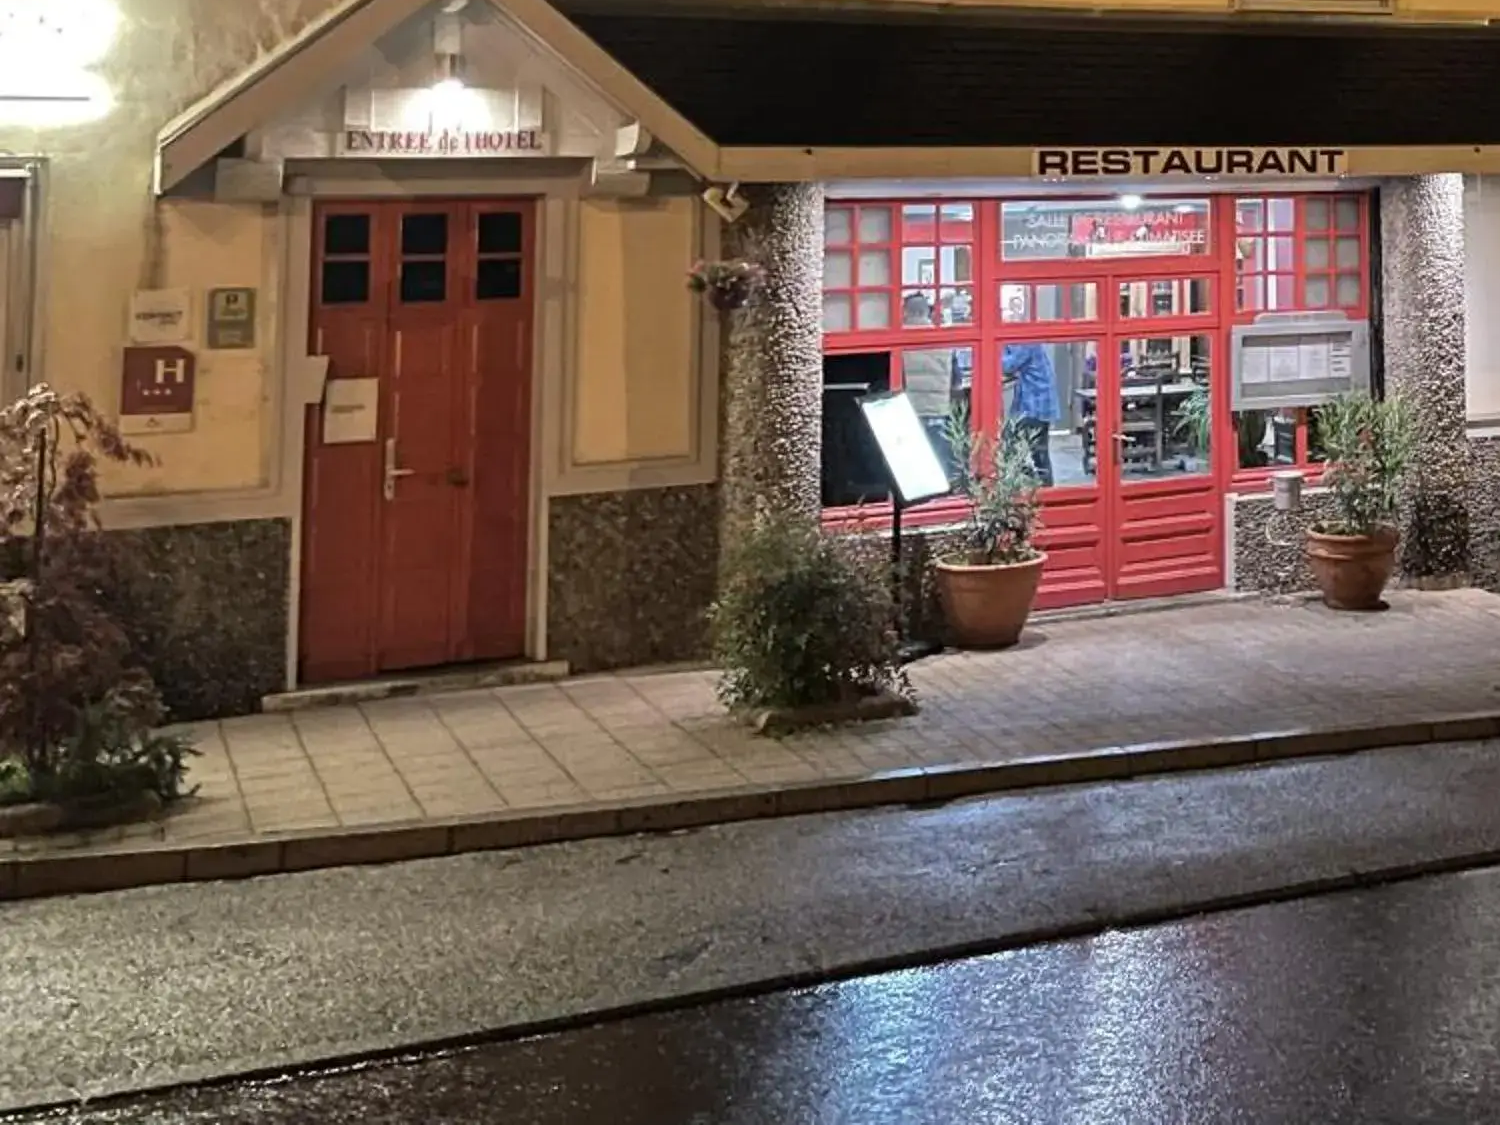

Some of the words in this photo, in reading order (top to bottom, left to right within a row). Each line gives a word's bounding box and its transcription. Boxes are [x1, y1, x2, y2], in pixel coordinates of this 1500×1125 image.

[438, 128, 459, 151] de
[465, 130, 543, 151] lHOTEL
[1038, 149, 1344, 175] RESTAURANT
[1130, 228, 1206, 245] IMATISEE
[156, 358, 186, 384] H
